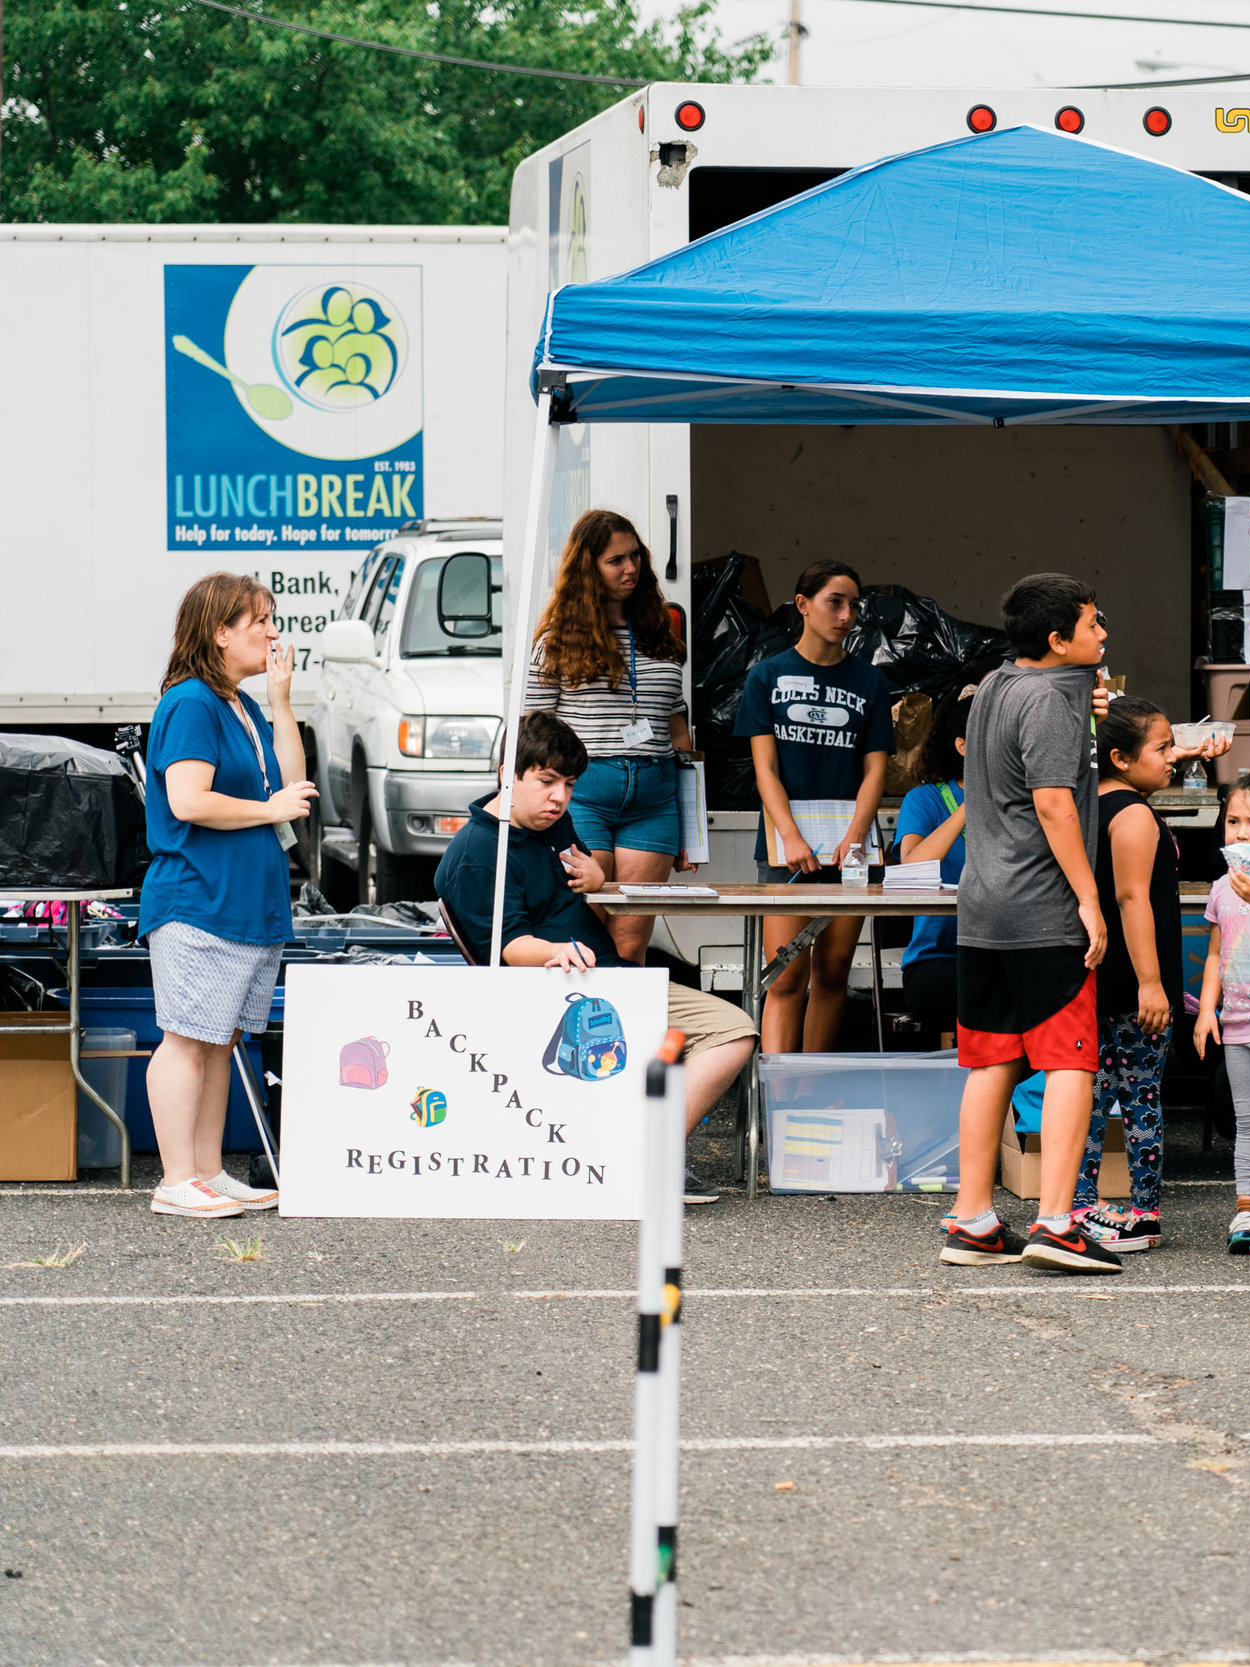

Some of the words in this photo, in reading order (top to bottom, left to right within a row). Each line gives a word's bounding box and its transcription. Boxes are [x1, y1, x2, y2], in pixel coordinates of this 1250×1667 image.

[374, 461, 392, 472] EST.
[394, 461, 416, 472] 1983
[175, 474, 416, 518] LUNCHBREAK
[175, 524, 206, 546] Help
[210, 524, 231, 541] for
[235, 524, 278, 546] today.
[281, 525, 318, 546] Hope
[320, 524, 341, 541] for
[271, 571, 339, 596] Bank,
[825, 686, 866, 716] NECK
[345, 1148, 607, 1185] REGISTRATION
